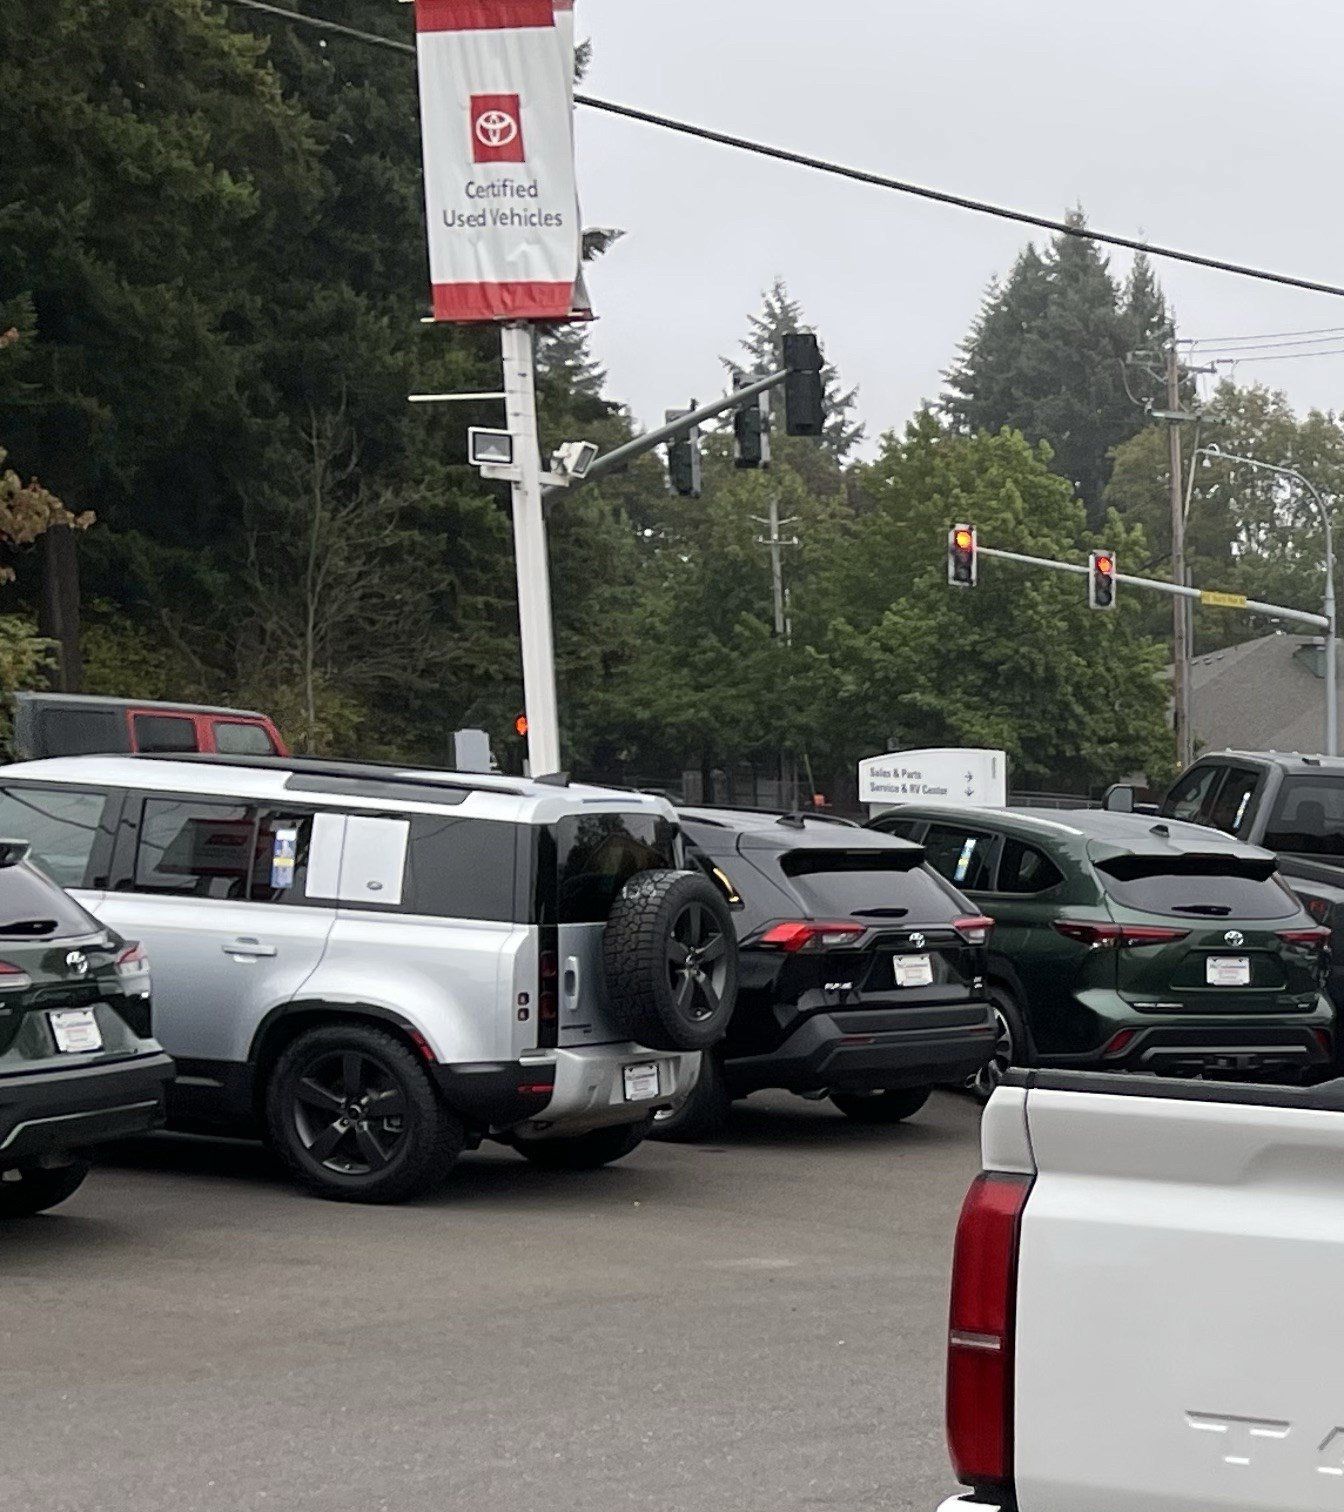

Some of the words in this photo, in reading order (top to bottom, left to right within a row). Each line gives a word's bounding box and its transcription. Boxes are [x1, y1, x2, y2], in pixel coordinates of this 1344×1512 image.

[464, 178, 539, 200] Certified
[442, 207, 487, 228] Used
[489, 206, 563, 228] Vehicles
